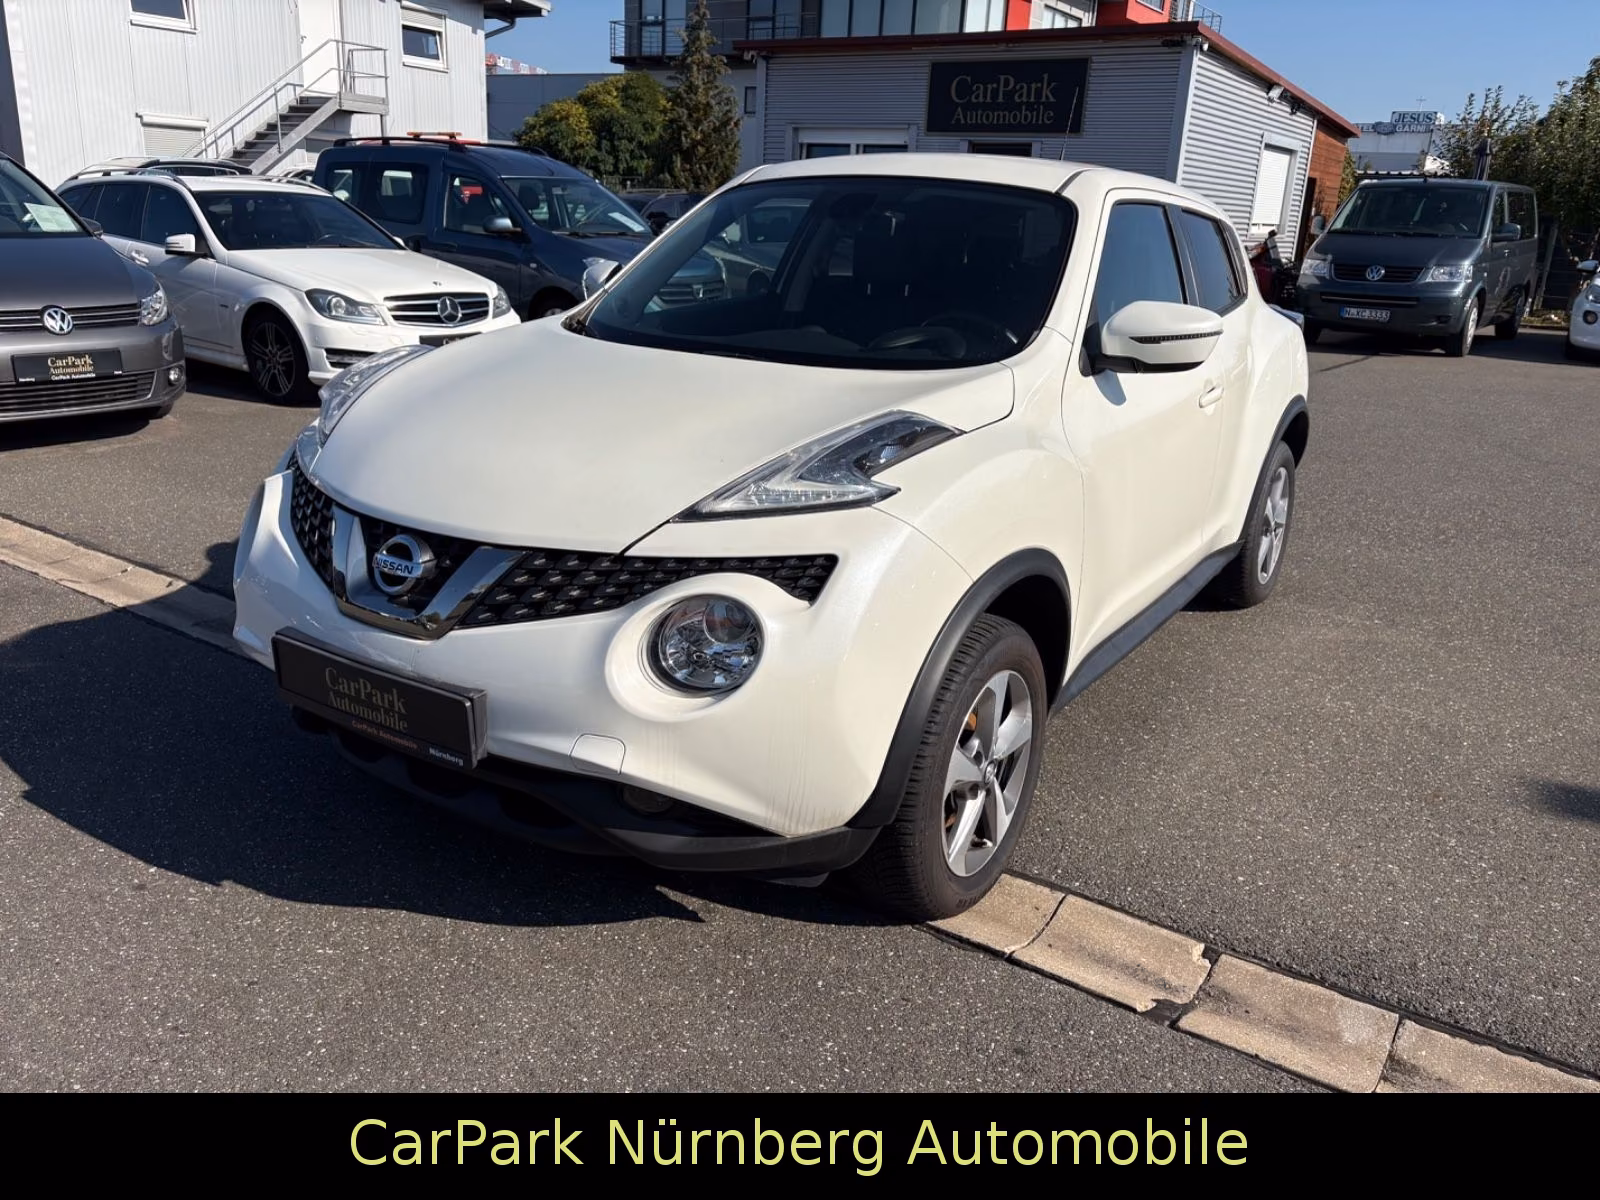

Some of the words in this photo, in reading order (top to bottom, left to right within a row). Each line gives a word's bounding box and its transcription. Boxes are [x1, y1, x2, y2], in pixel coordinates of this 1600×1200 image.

[949, 73, 1060, 104] CarPark
[950, 104, 1055, 125] Automobile
[1394, 112, 1433, 123] JESUS
[1395, 124, 1426, 132] GARNI
[47, 354, 94, 368] CarPark
[49, 364, 94, 375] Automobile
[373, 556, 415, 575] NISSAN
[325, 666, 408, 716] CarPark
[329, 690, 408, 734] Automobile
[429, 746, 464, 768] Nürnberg
